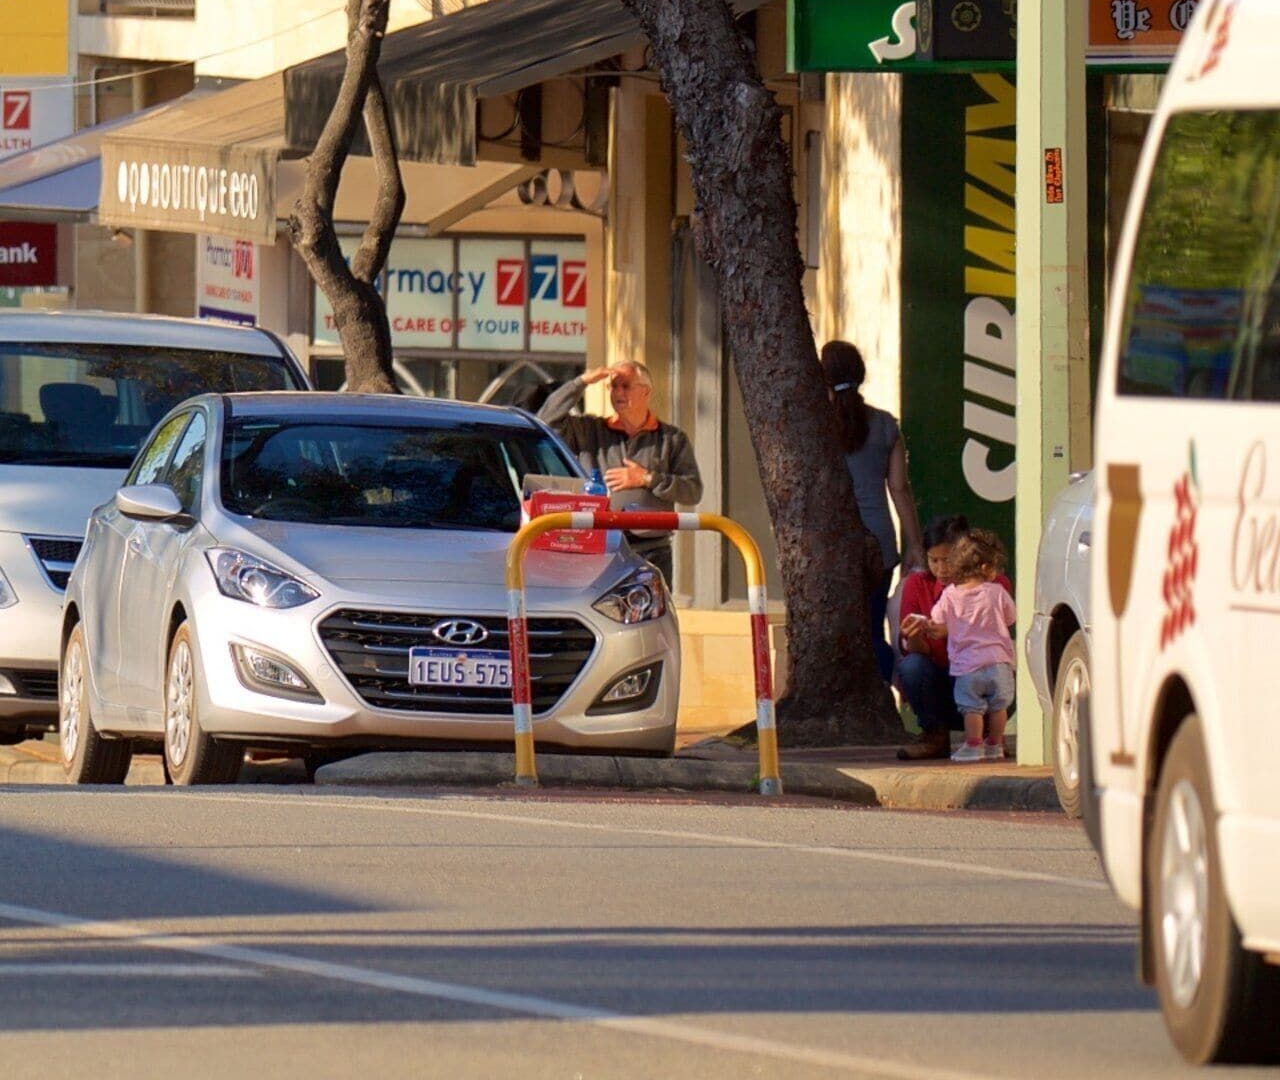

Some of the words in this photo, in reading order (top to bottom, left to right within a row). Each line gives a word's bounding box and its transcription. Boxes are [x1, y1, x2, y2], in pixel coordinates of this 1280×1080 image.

[393, 318, 435, 333] CARE
[440, 318, 466, 333] OF
[475, 318, 519, 334] YOUR
